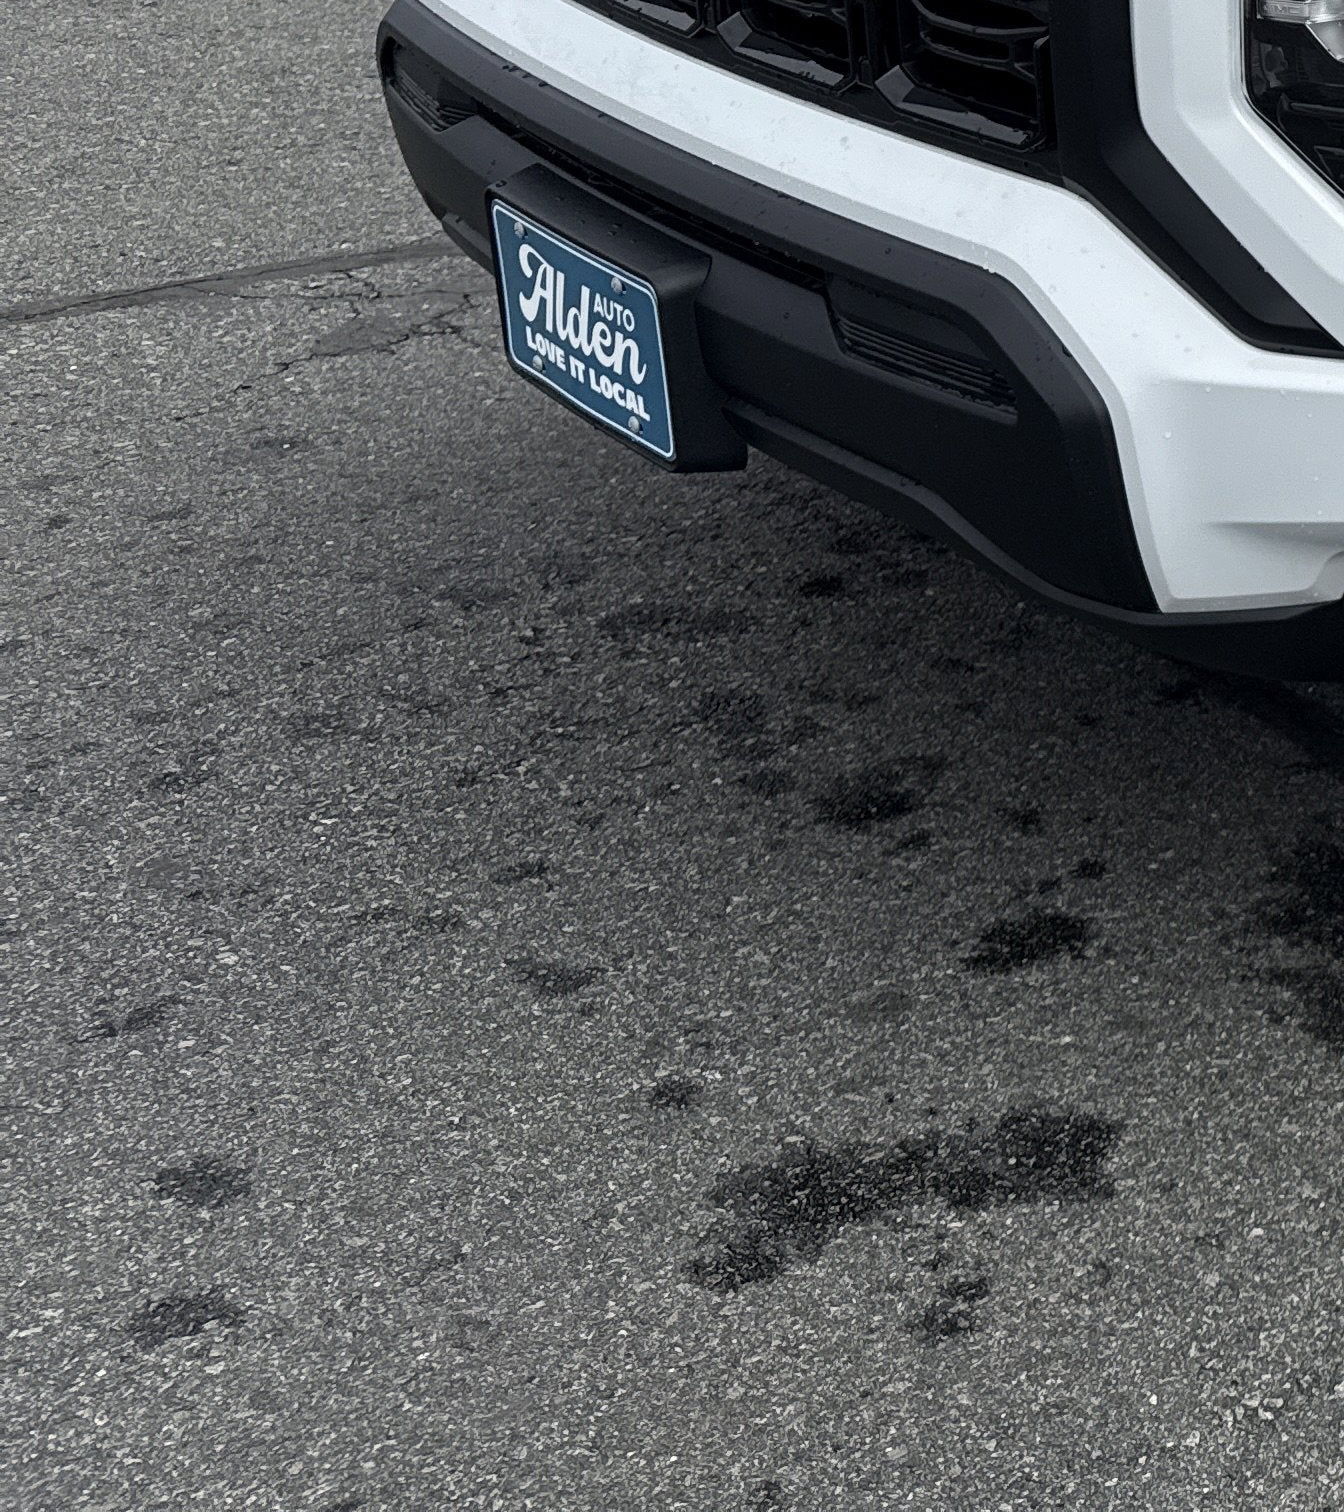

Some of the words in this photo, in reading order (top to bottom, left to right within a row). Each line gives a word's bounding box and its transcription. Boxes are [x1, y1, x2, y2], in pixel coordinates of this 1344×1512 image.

[518, 242, 648, 386] Alden
[592, 292, 636, 333] AUTO
[525, 325, 567, 373] LOVE
[569, 354, 586, 385] IT
[588, 367, 652, 423] LOCAL
